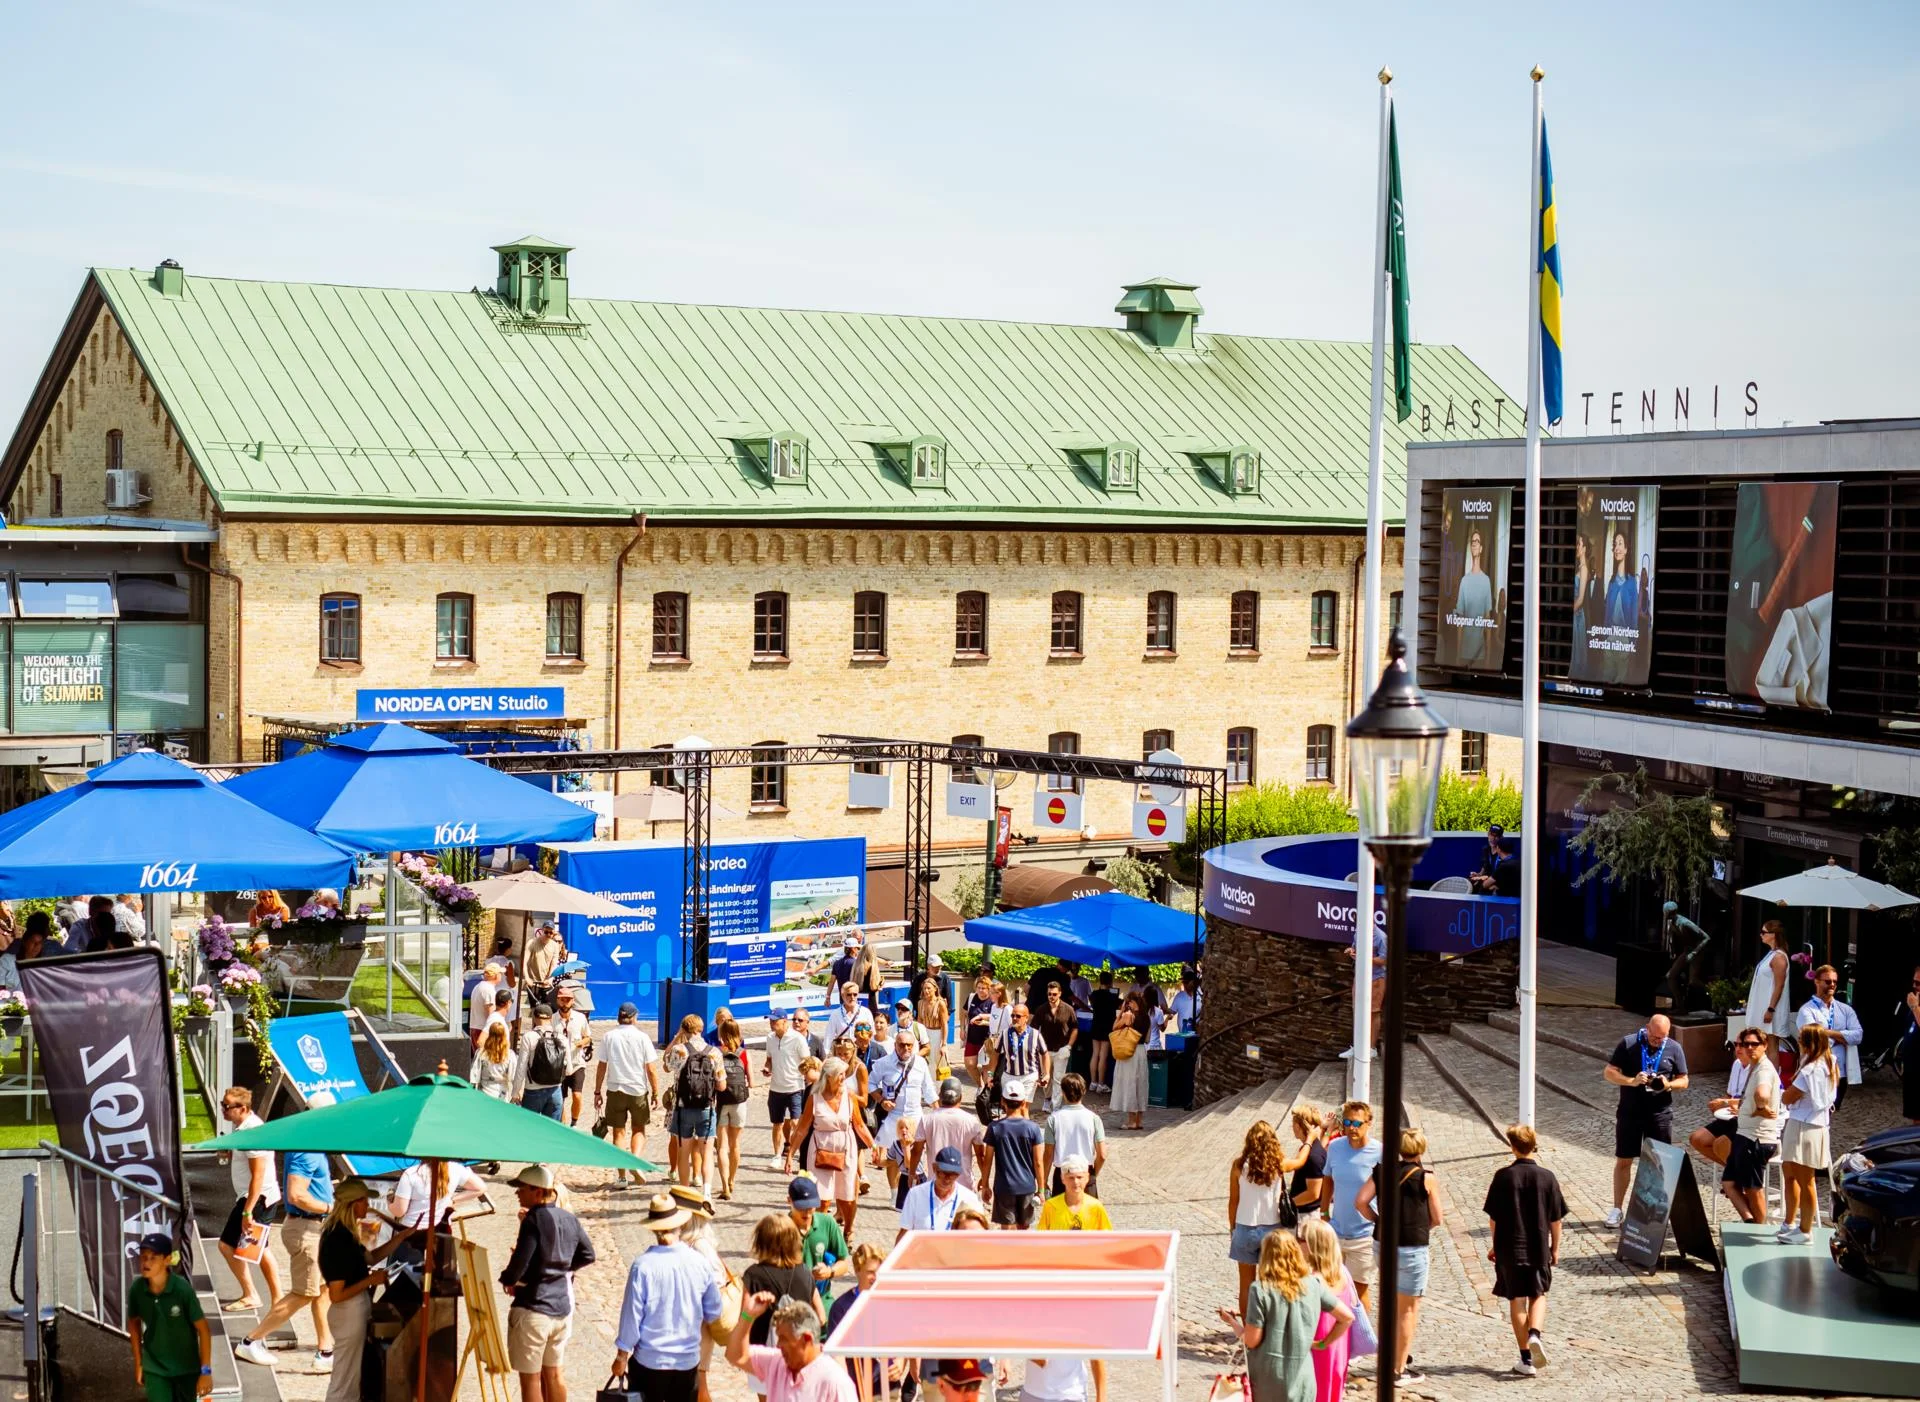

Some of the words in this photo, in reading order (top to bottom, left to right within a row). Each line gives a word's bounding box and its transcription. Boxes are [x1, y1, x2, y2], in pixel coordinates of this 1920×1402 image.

[1422, 395, 1562, 432] BÅST
[1581, 381, 1758, 425] TENNIS
[1462, 499, 1492, 513] Nordea
[1600, 498, 1635, 513] Nordea
[1613, 625, 1639, 638] Nordens
[1589, 639, 1610, 650] största
[23, 655, 70, 667] WELCOME
[71, 655, 84, 667] TO
[86, 655, 103, 666] THE
[23, 667, 103, 685] HIGHLIGHT
[22, 685, 41, 703] OF
[43, 685, 104, 703] SUMMER
[375, 697, 445, 713] NORDEA
[447, 696, 493, 712] OPEN
[498, 695, 548, 711] Studio
[960, 796, 976, 806] EXIT
[434, 820, 480, 845] 1664
[140, 860, 199, 889] 1664
[1220, 882, 1256, 907] Nordea
[1317, 901, 1387, 926] Nora
[587, 924, 617, 936] Open
[619, 920, 656, 933] Studio
[1324, 923, 1348, 932] PRIVATE
[748, 943, 766, 953] EXIT
